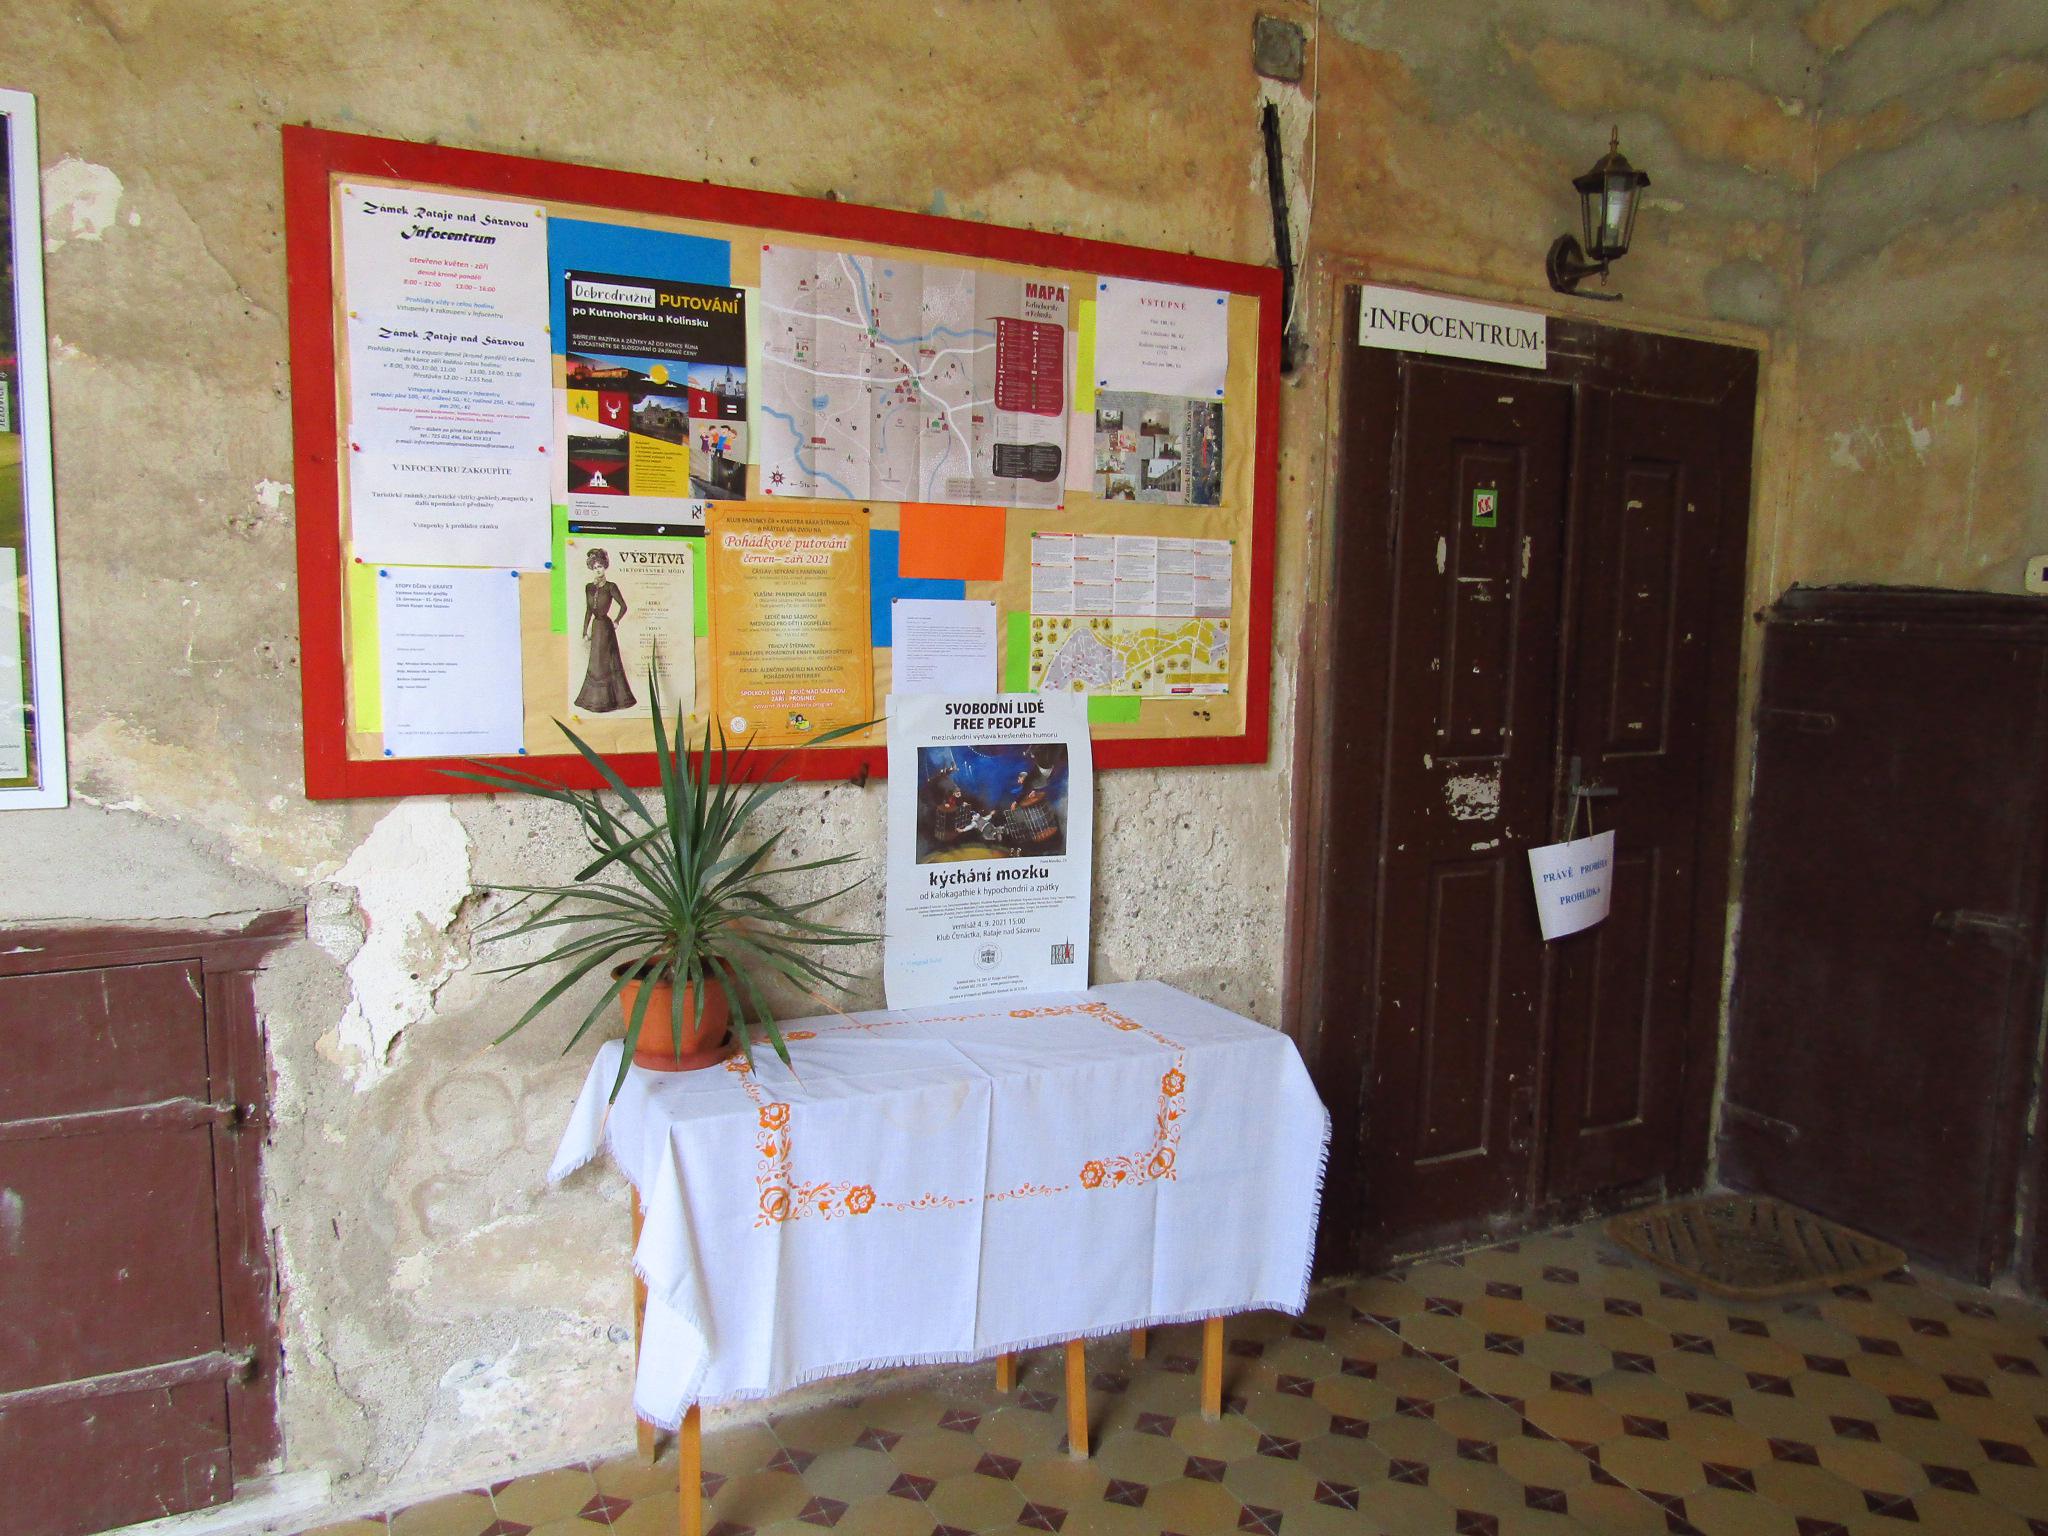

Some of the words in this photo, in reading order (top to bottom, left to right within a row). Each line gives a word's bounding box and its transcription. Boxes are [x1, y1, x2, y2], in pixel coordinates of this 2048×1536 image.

[362, 201, 409, 215] Zámek
[413, 206, 453, 222] Rataje
[457, 213, 476, 222] nad
[480, 214, 529, 229] Sázavou
[401, 224, 496, 246] Infocentrum
[444, 258, 469, 269] květen
[1026, 283, 1065, 302] MAPA
[660, 293, 738, 315] PUTOVÁNÍ
[572, 308, 586, 317] po
[588, 307, 656, 323] Kutnohorsku
[666, 314, 709, 328] Kolínsku
[1369, 307, 1538, 350] INFOCENTRUM
[378, 327, 419, 339] Zámek
[423, 331, 457, 343] Rataje
[460, 335, 478, 343] nad
[481, 336, 525, 347] Sázavou
[392, 463, 399, 471] V
[401, 464, 460, 474] INFOCENTRU
[462, 466, 512, 475] ZAKOUPÍTE
[725, 534, 791, 550] Pohádkové
[794, 538, 848, 552] putování
[619, 550, 684, 565] VÝSTAVA
[784, 555, 803, 563] září
[806, 555, 829, 564] 2021
[945, 700, 1013, 715] SVOBODNÍ
[1016, 699, 1045, 714] LIDÉ
[953, 717, 984, 730] FREE
[987, 716, 1036, 729] PEOPLE
[931, 733, 972, 741] mezinárodní
[973, 733, 996, 741] výstava
[997, 732, 1032, 740] kresleného
[1032, 731, 1058, 739] humoru
[929, 868, 990, 889] kýchání
[996, 865, 1049, 880] mozku
[1543, 866, 1574, 882] PRÁVĚ
[919, 891, 929, 900] od
[930, 888, 976, 900] kalokagathie
[983, 885, 1028, 896] hypochondrii
[1036, 883, 1060, 893] zpátky
[952, 921, 976, 930] vernisáž
[992, 919, 1007, 927] 2021
[1009, 917, 1026, 926] 15:00
[936, 933, 950, 942] Klub
[983, 930, 1002, 938] Rataje
